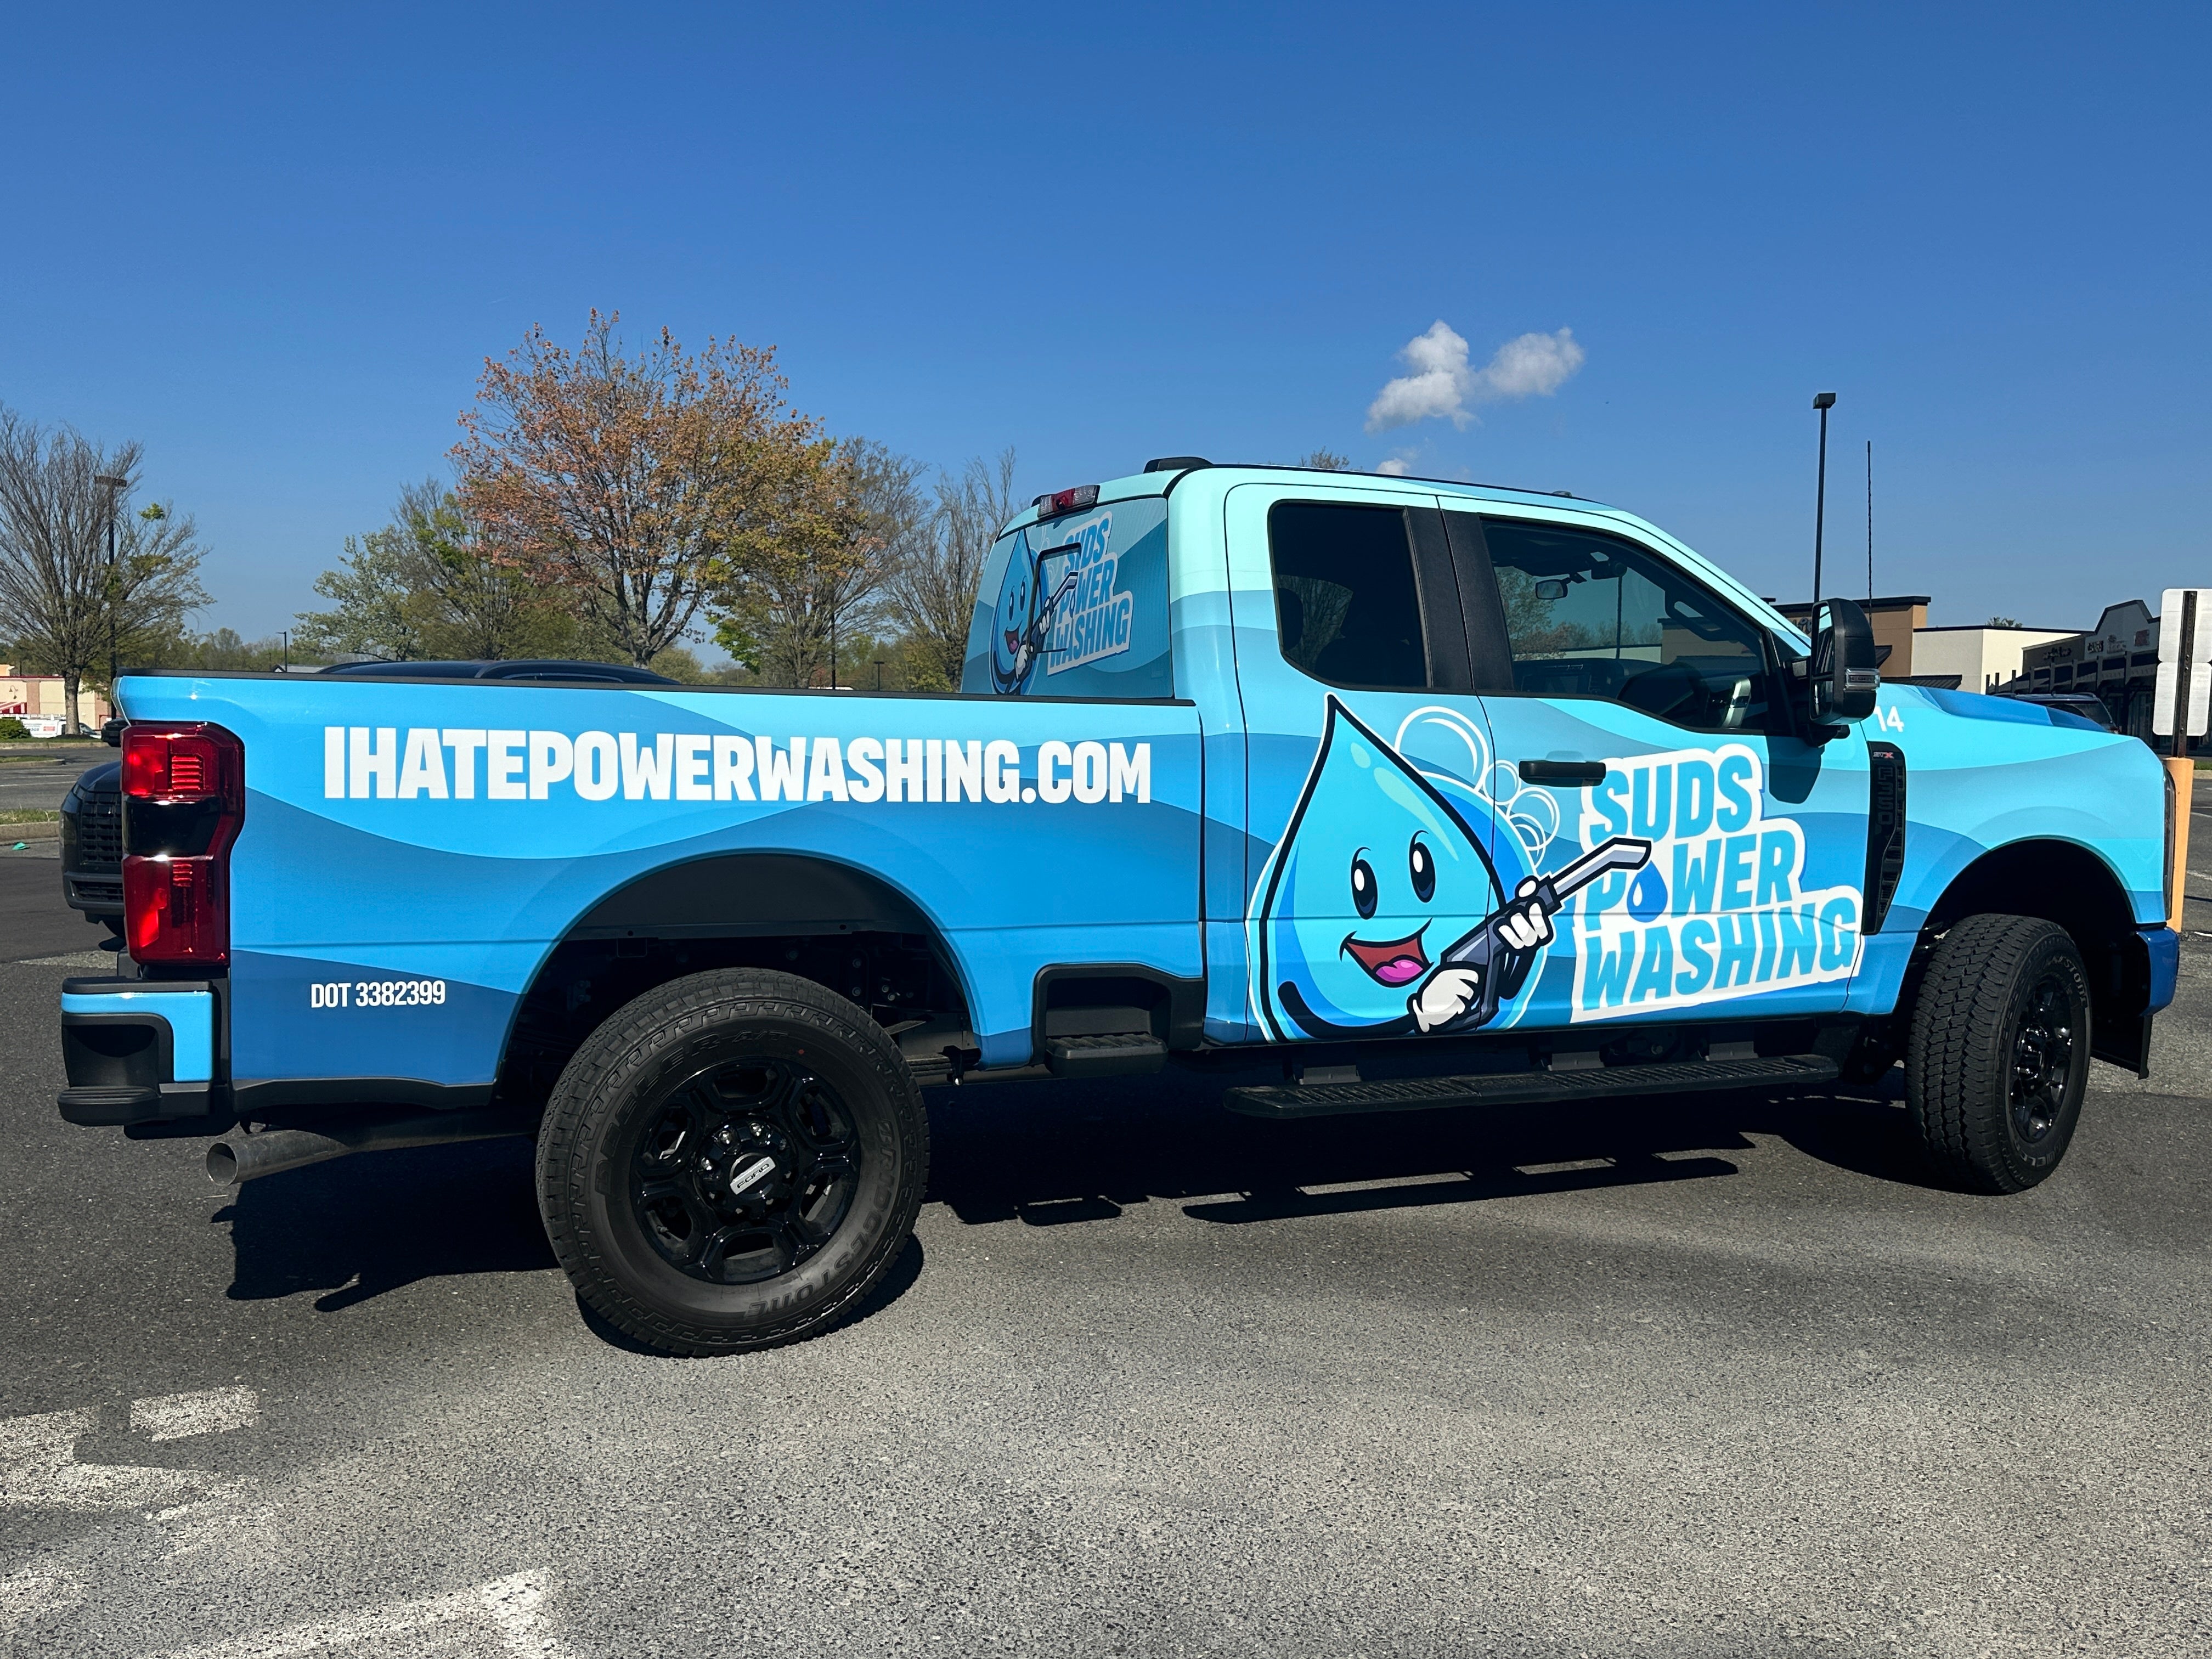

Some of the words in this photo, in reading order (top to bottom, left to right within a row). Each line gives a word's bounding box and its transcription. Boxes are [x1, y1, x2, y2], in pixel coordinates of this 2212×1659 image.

[1874, 706, 1904, 732] 14
[324, 726, 1151, 804] IHATEPOWERWASHING.COM
[1589, 755, 1753, 847] SUDS
[1584, 830, 1796, 932] POWER
[311, 983, 352, 1008] DOT
[356, 980, 446, 1007] 3382399
[1582, 896, 1857, 1011] WASHING
[737, 1163, 770, 1188] FORD
[743, 1119, 897, 1318] BRIDGESTONE
